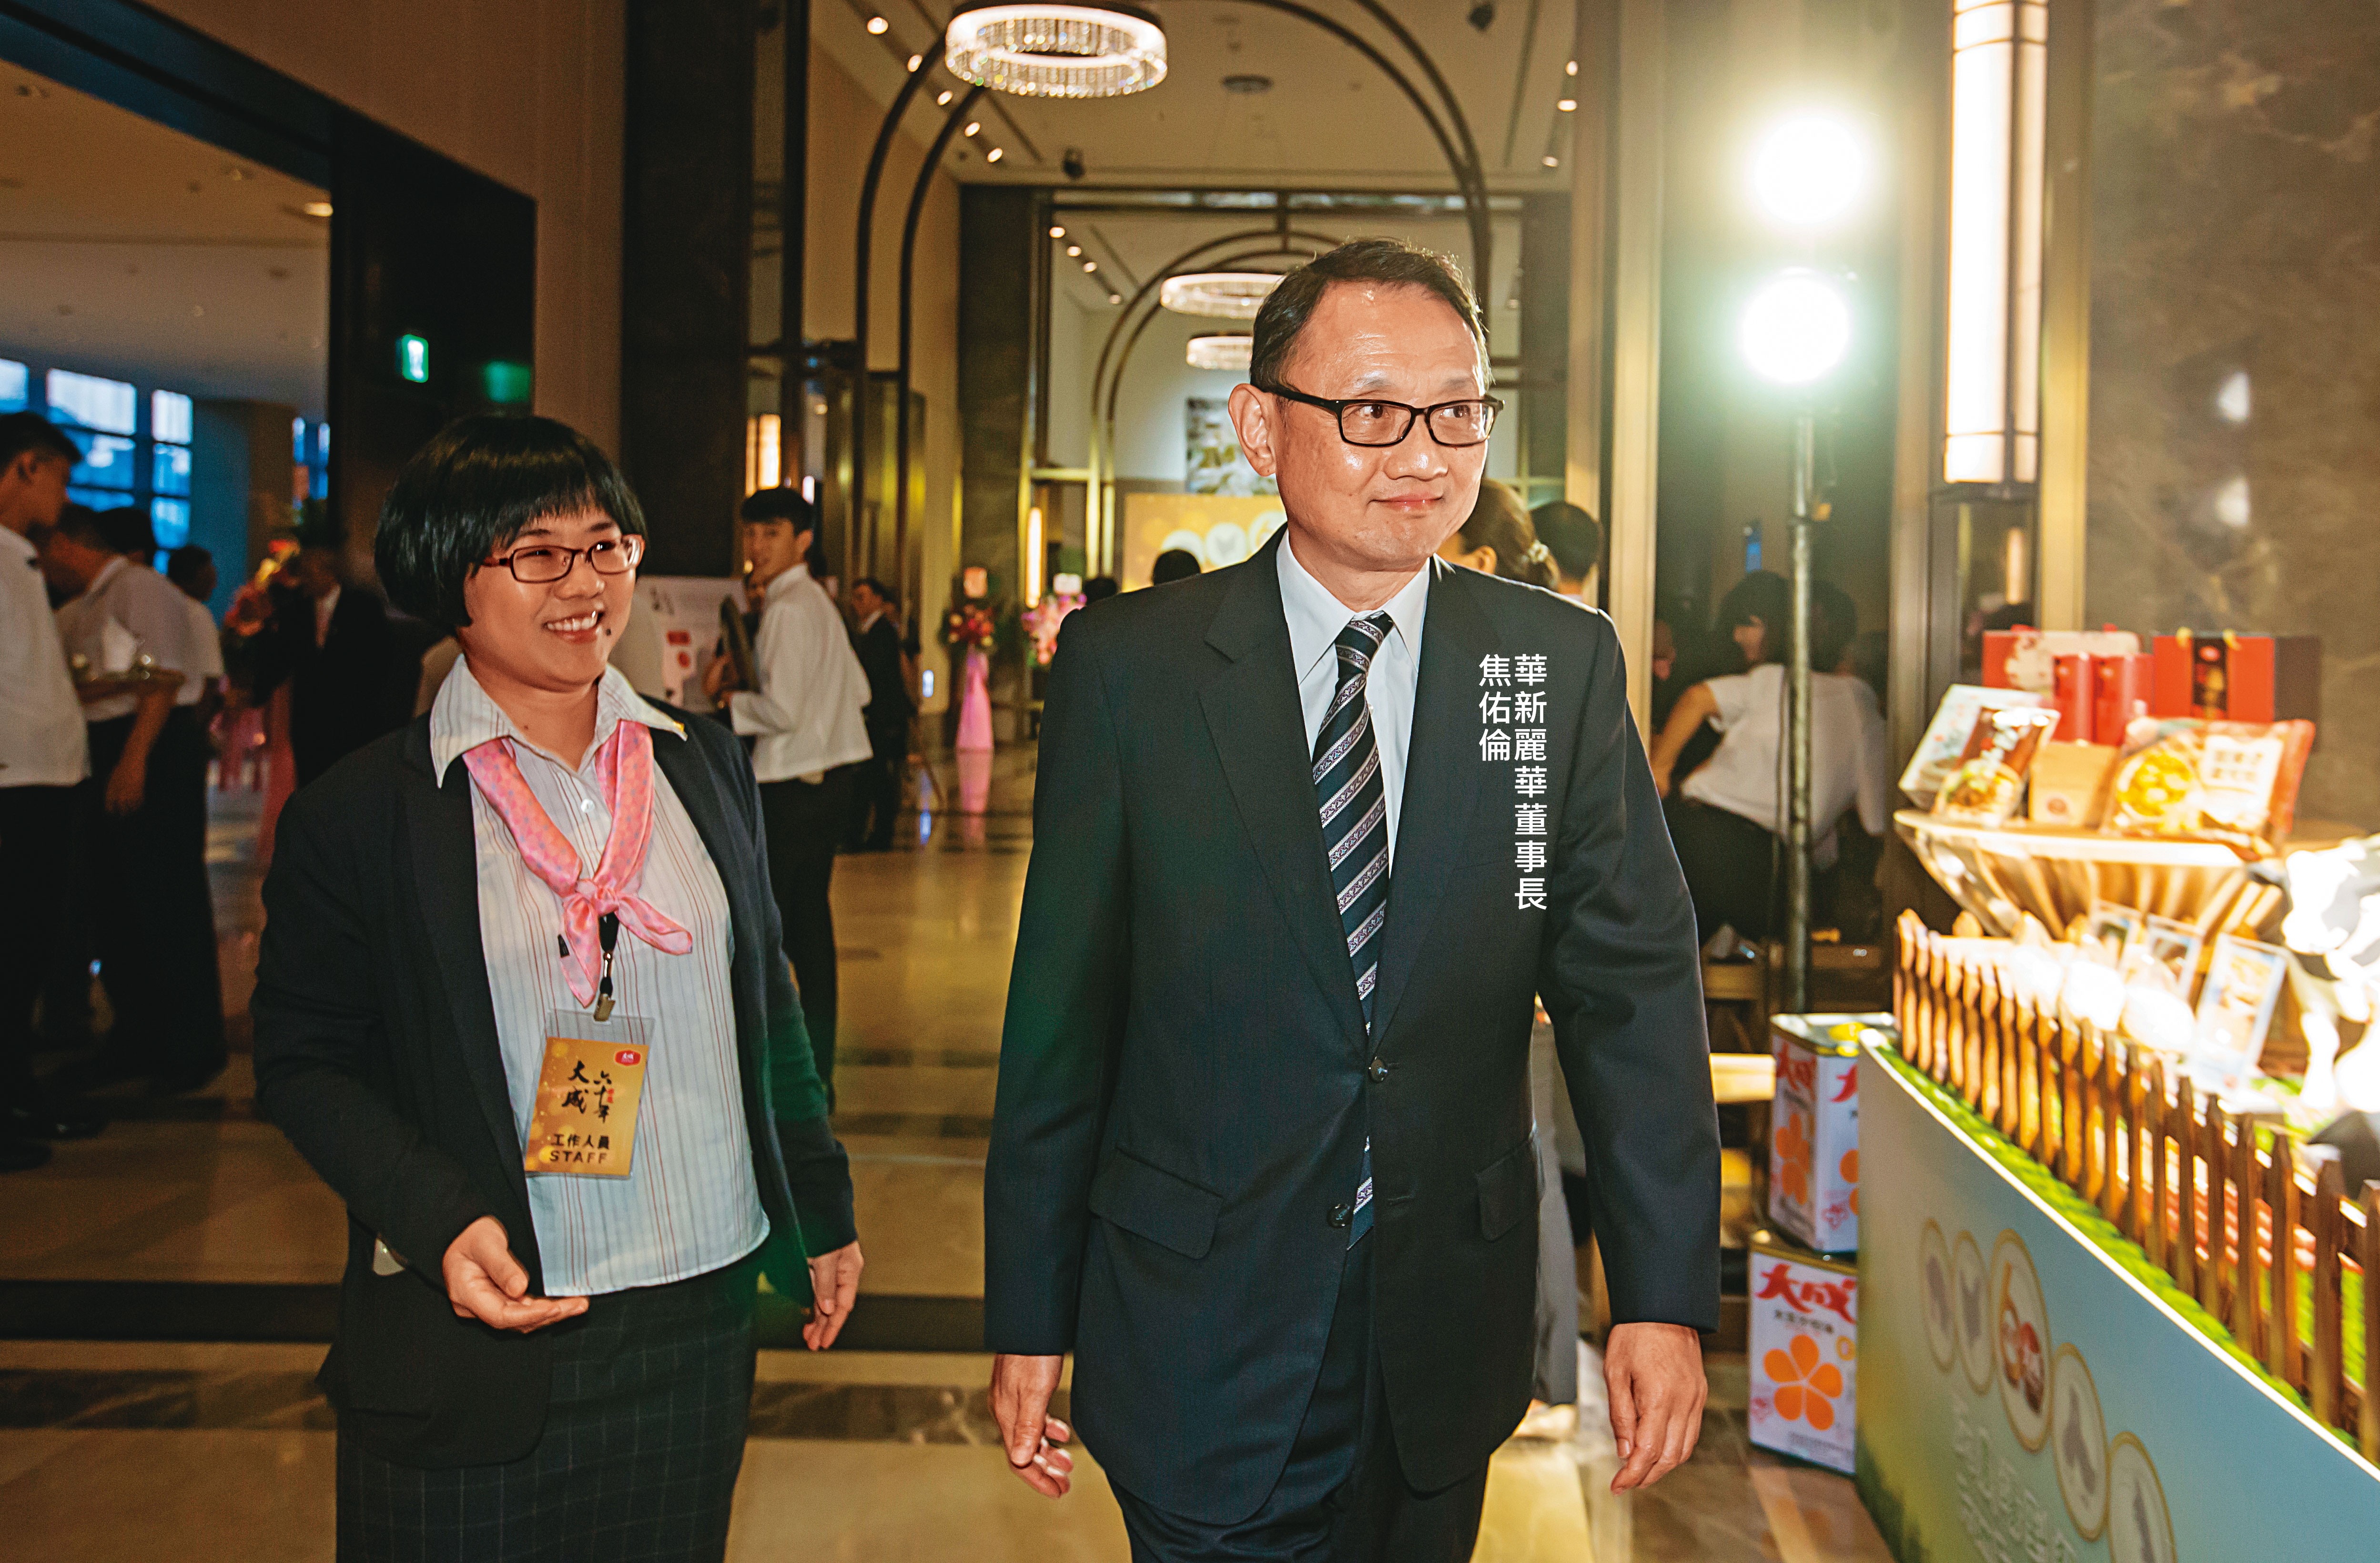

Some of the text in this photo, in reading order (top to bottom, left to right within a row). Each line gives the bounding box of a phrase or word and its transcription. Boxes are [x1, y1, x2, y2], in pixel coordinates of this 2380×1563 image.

[561, 1060, 589, 1115] 大成
[550, 1134, 609, 1149] 工作人員
[550, 1150, 608, 1163] STAFF
[1755, 1264, 1856, 1325] 大成
